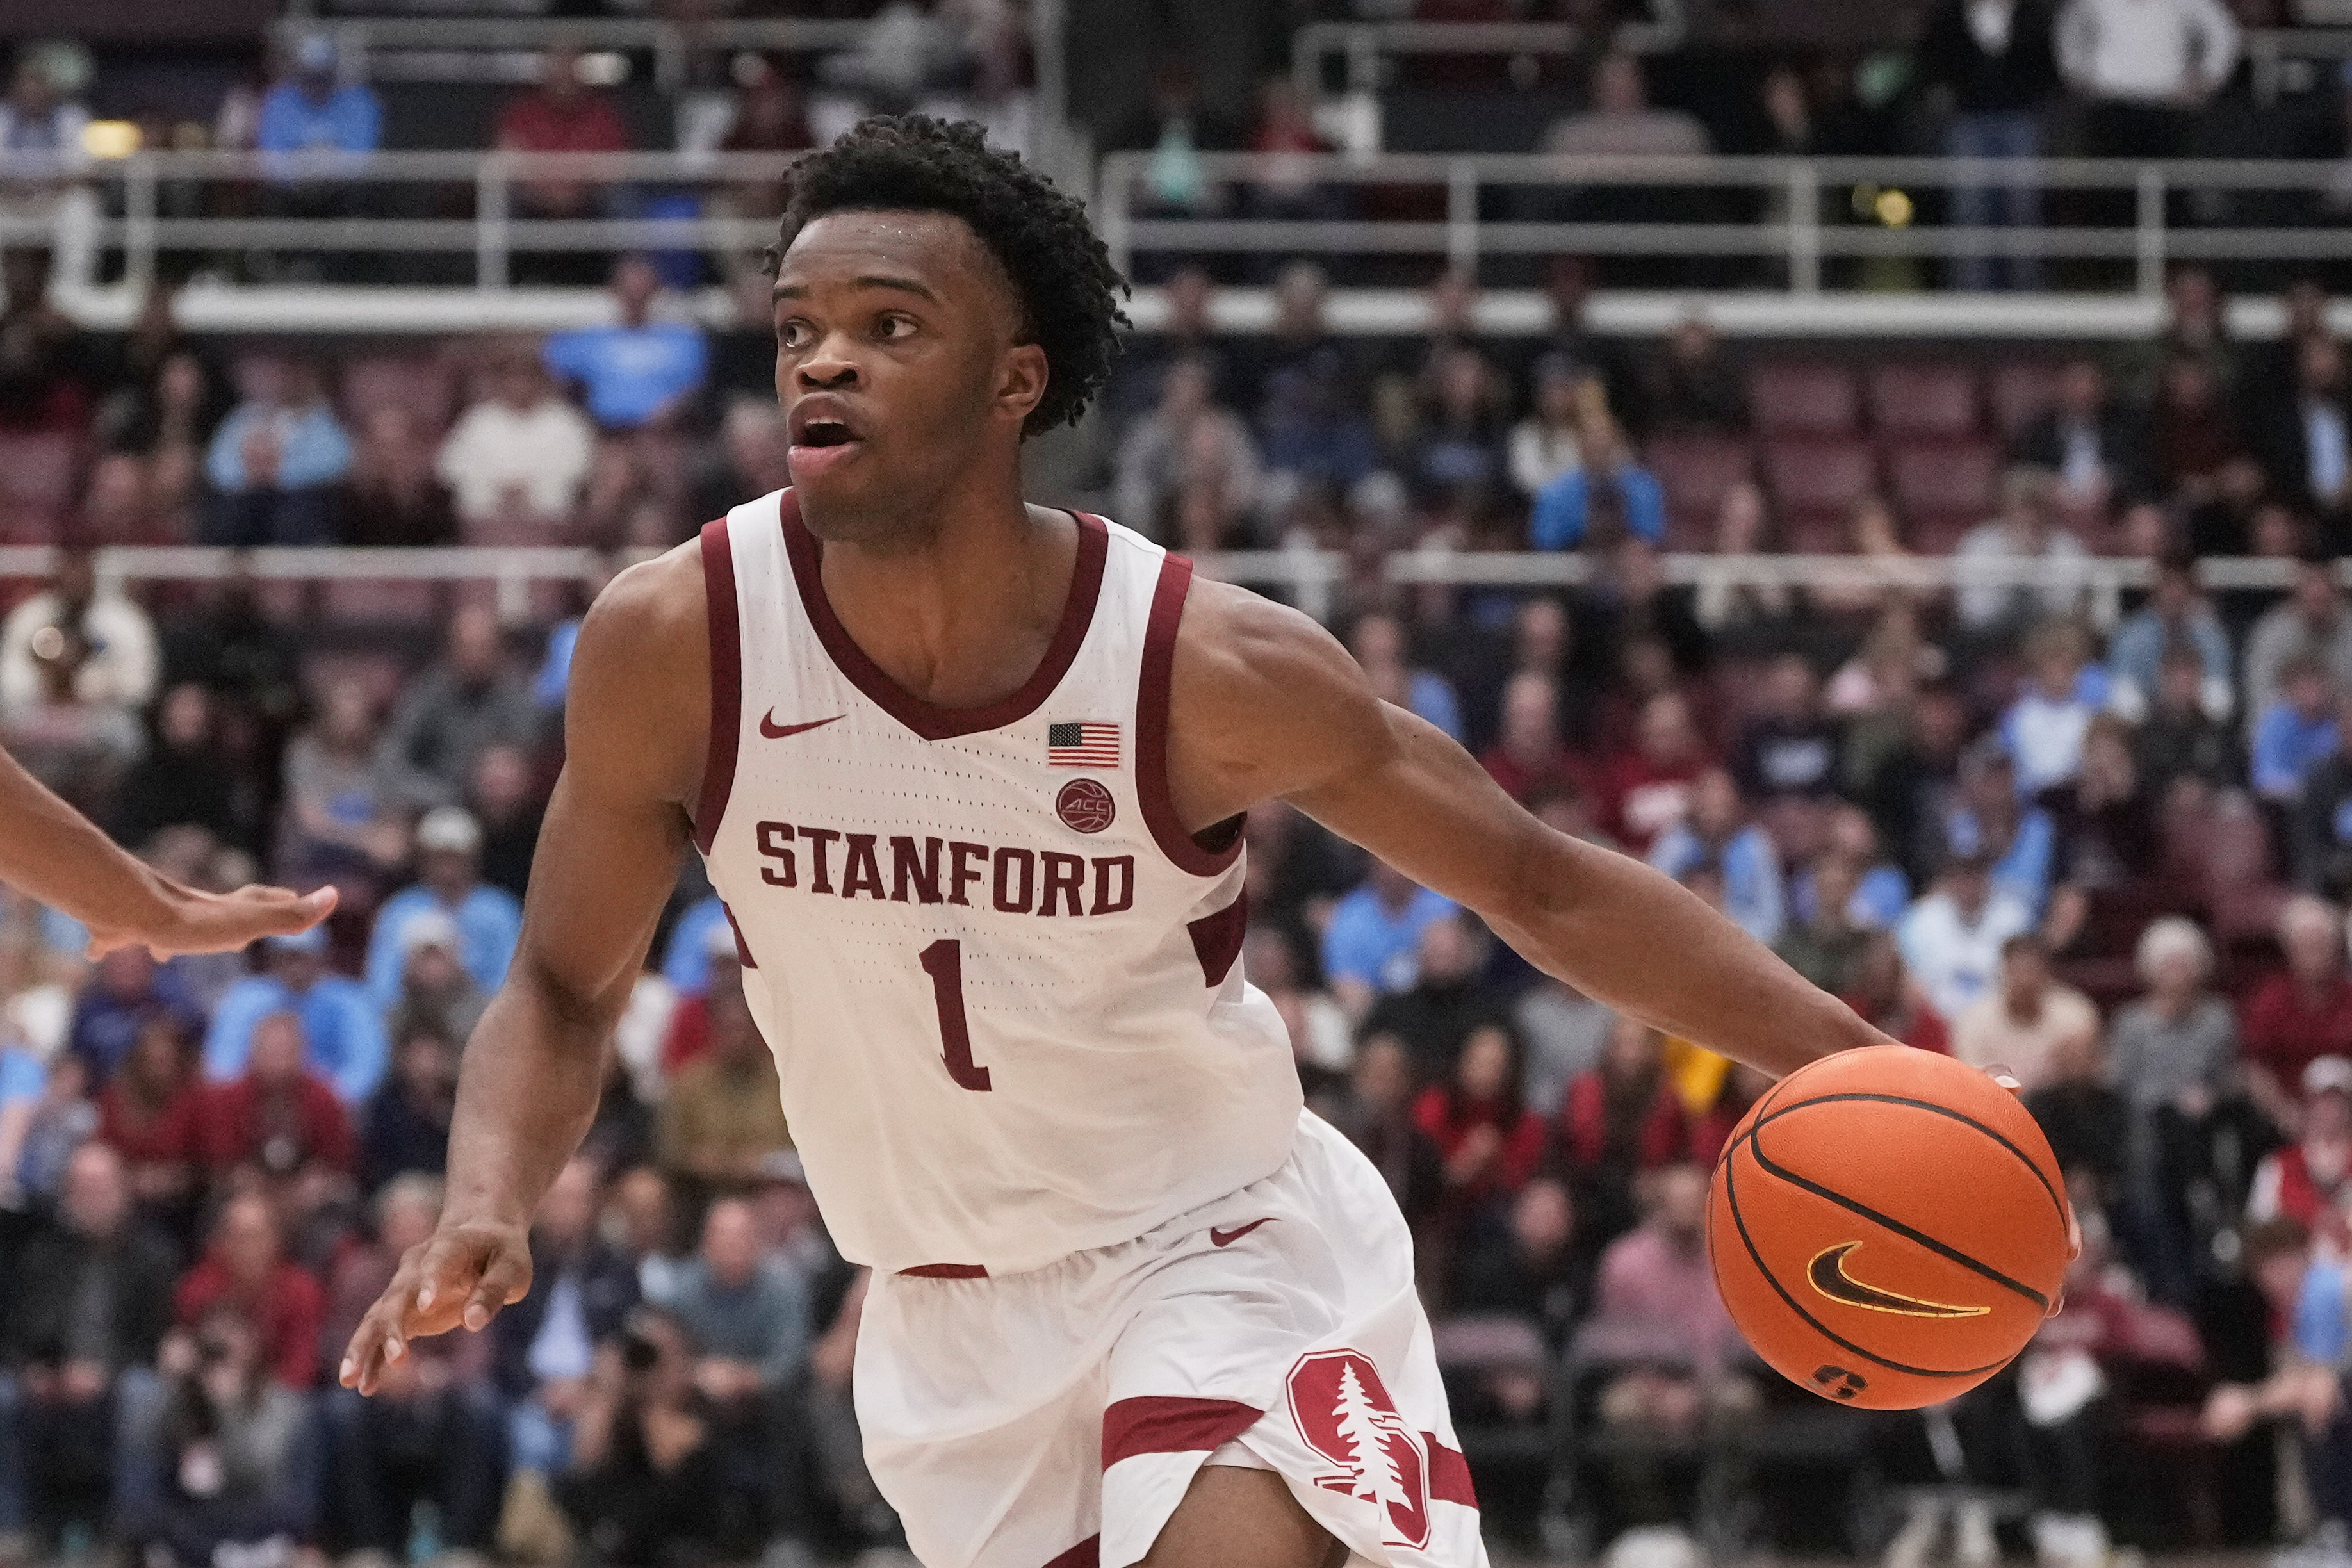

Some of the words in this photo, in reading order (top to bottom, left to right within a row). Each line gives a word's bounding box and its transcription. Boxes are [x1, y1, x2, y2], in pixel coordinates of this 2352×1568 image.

[1065, 798, 1110, 812] ACC
[756, 821, 1134, 917] STANFORD
[919, 939, 992, 1091] 1
